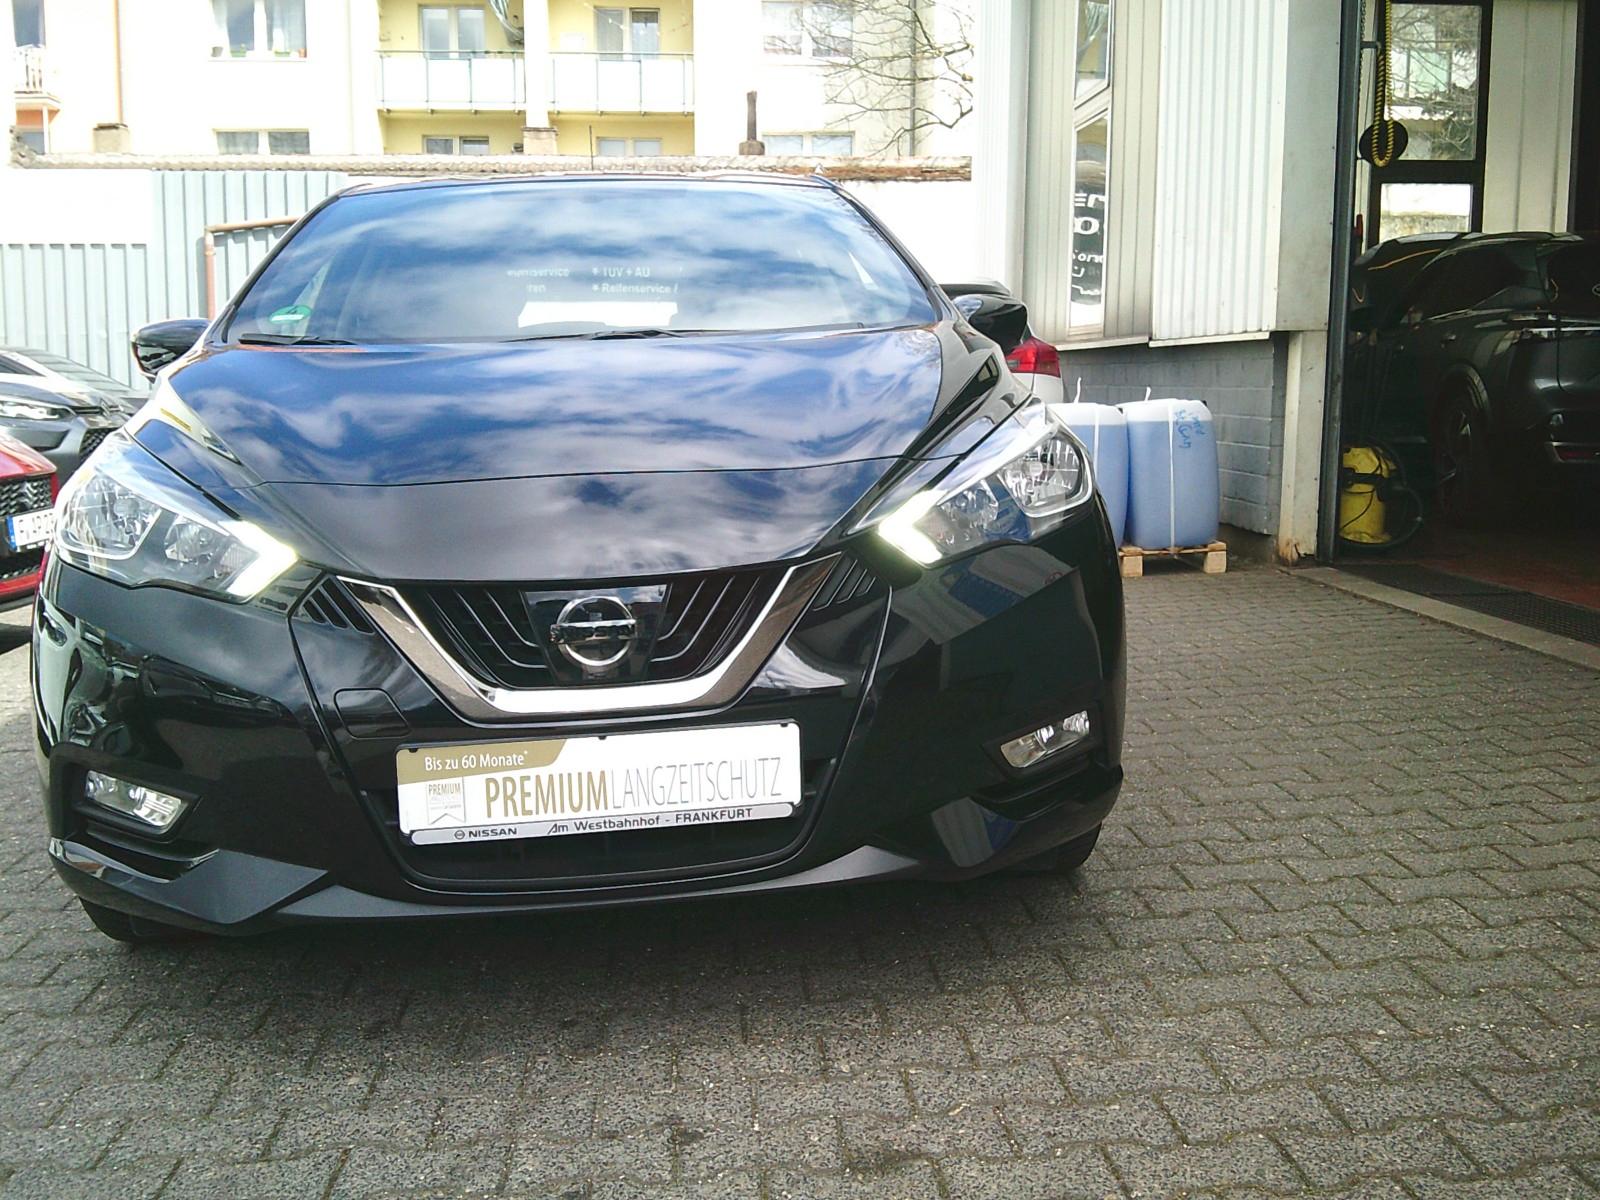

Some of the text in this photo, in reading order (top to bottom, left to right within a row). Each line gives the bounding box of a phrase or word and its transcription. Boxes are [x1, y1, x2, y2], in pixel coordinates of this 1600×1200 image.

[424, 756, 442, 771] Bis
[445, 758, 459, 769] zu
[461, 755, 476, 769] 60
[428, 783, 461, 796] PREMIUM
[547, 823, 568, 835] Am
[574, 815, 660, 831] Westbahnhof
[675, 808, 752, 824] FRANKFURT
[468, 827, 518, 838] NISSAN
